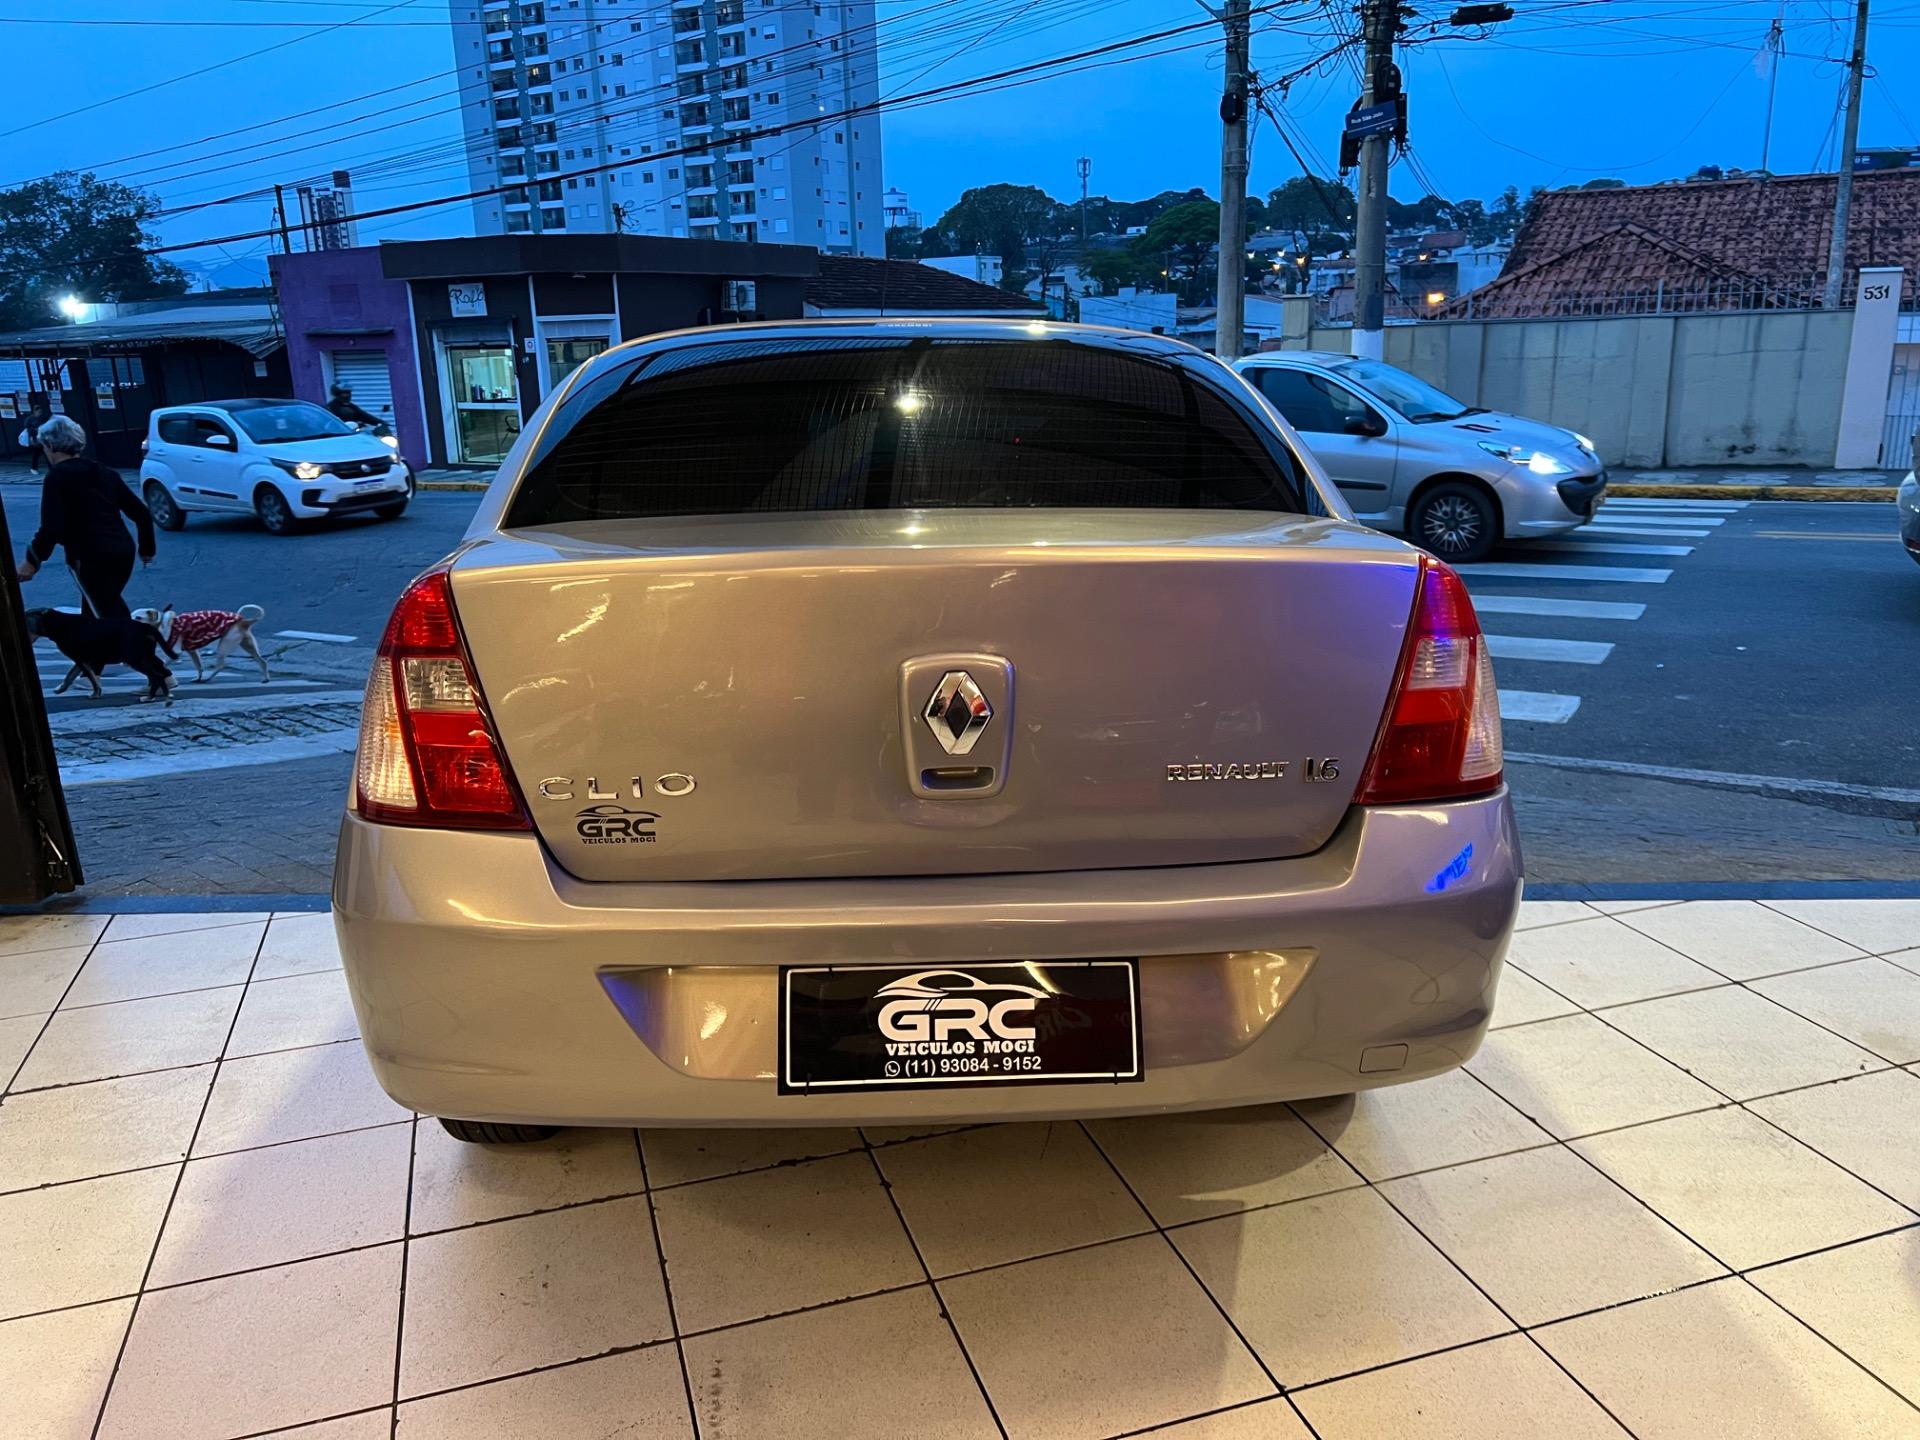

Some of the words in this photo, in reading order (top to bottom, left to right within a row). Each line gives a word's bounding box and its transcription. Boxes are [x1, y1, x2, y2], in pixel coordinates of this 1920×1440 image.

[1864, 285, 1890, 300] 531
[1166, 761, 1290, 781] RENAULT
[537, 772, 698, 801] CLIO
[576, 817, 656, 837] GRC
[581, 837, 627, 845] VEICULOS
[877, 998, 1036, 1041] GRC
[885, 1041, 976, 1056] VEICULOS
[983, 1039, 1035, 1054] MOGI
[904, 1058, 937, 1078] (11)
[940, 1057, 990, 1073] 93084
[1003, 1056, 1042, 1071] 9152
